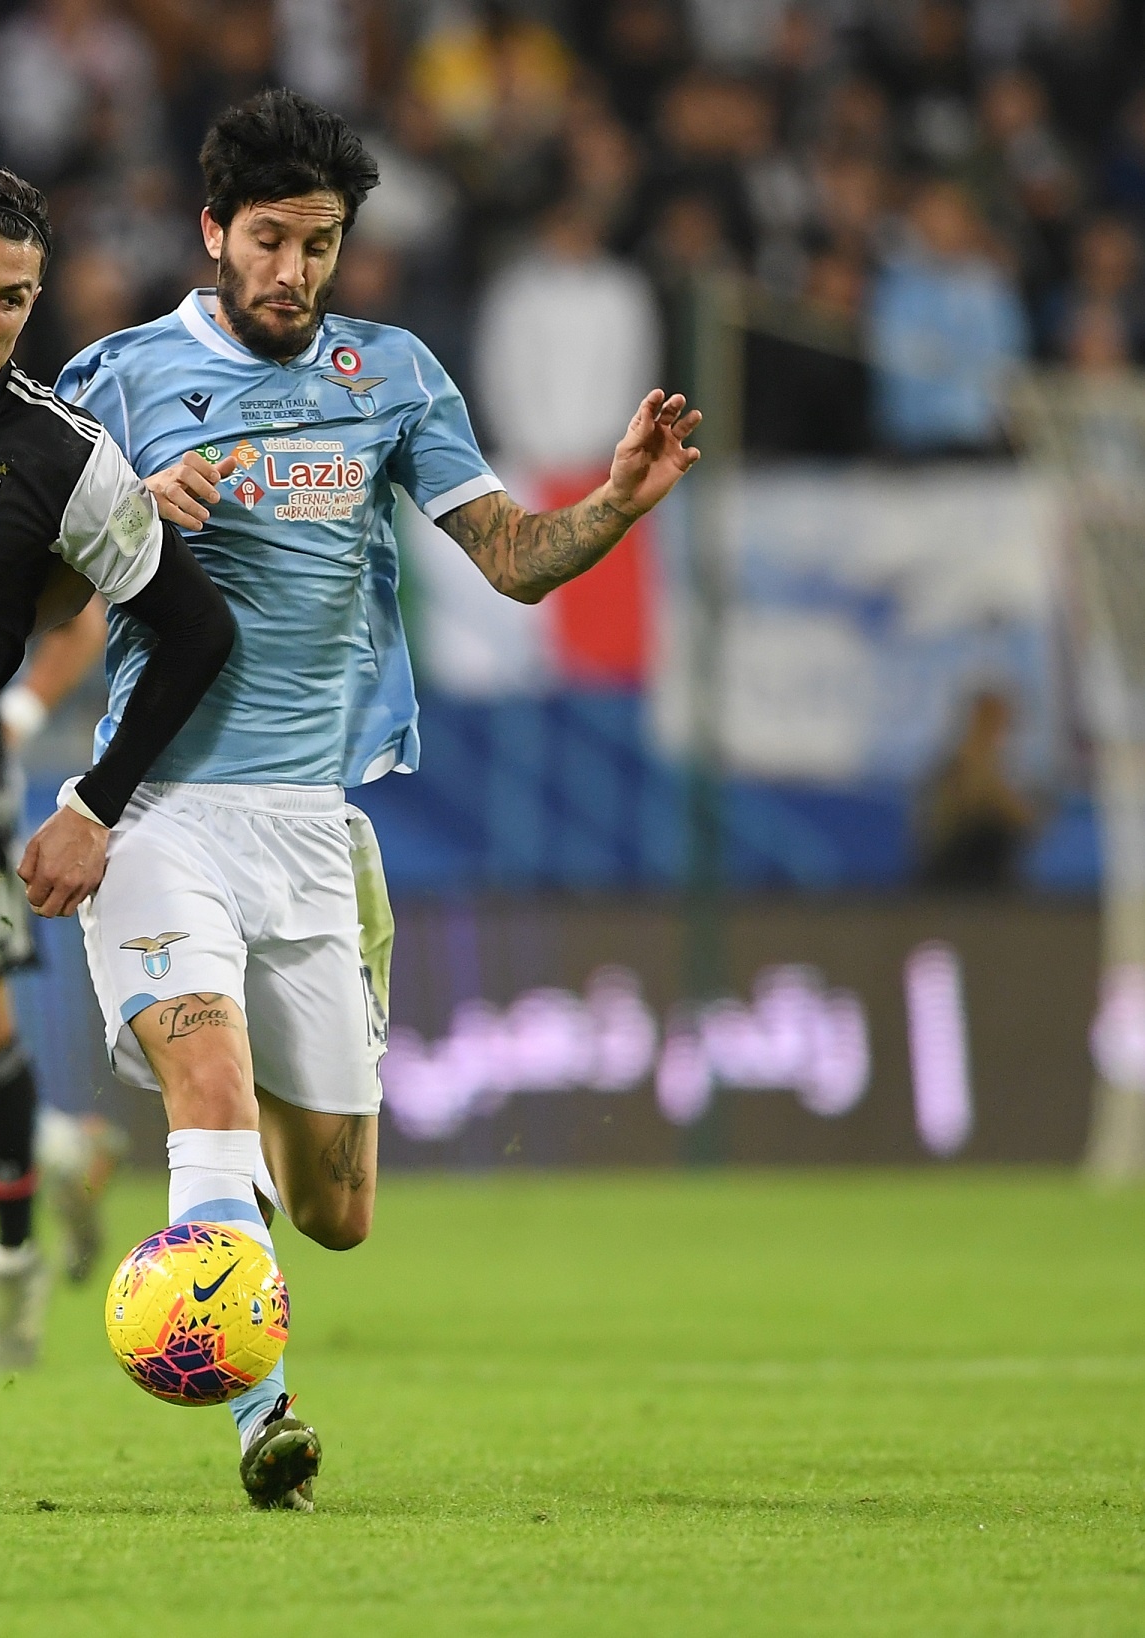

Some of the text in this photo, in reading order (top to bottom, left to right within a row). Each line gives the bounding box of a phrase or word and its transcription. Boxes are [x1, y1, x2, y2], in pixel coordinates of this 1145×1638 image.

[239, 398, 319, 410] SUPERCOPPA ITALIANA
[263, 411, 272, 420] 22
[273, 409, 305, 419] DICEMBRE
[264, 439, 342, 450] visitlazio.com
[267, 455, 363, 488] Lazio
[290, 492, 330, 505] ETERNAL
[276, 505, 352, 519] EMBRACING ROME
